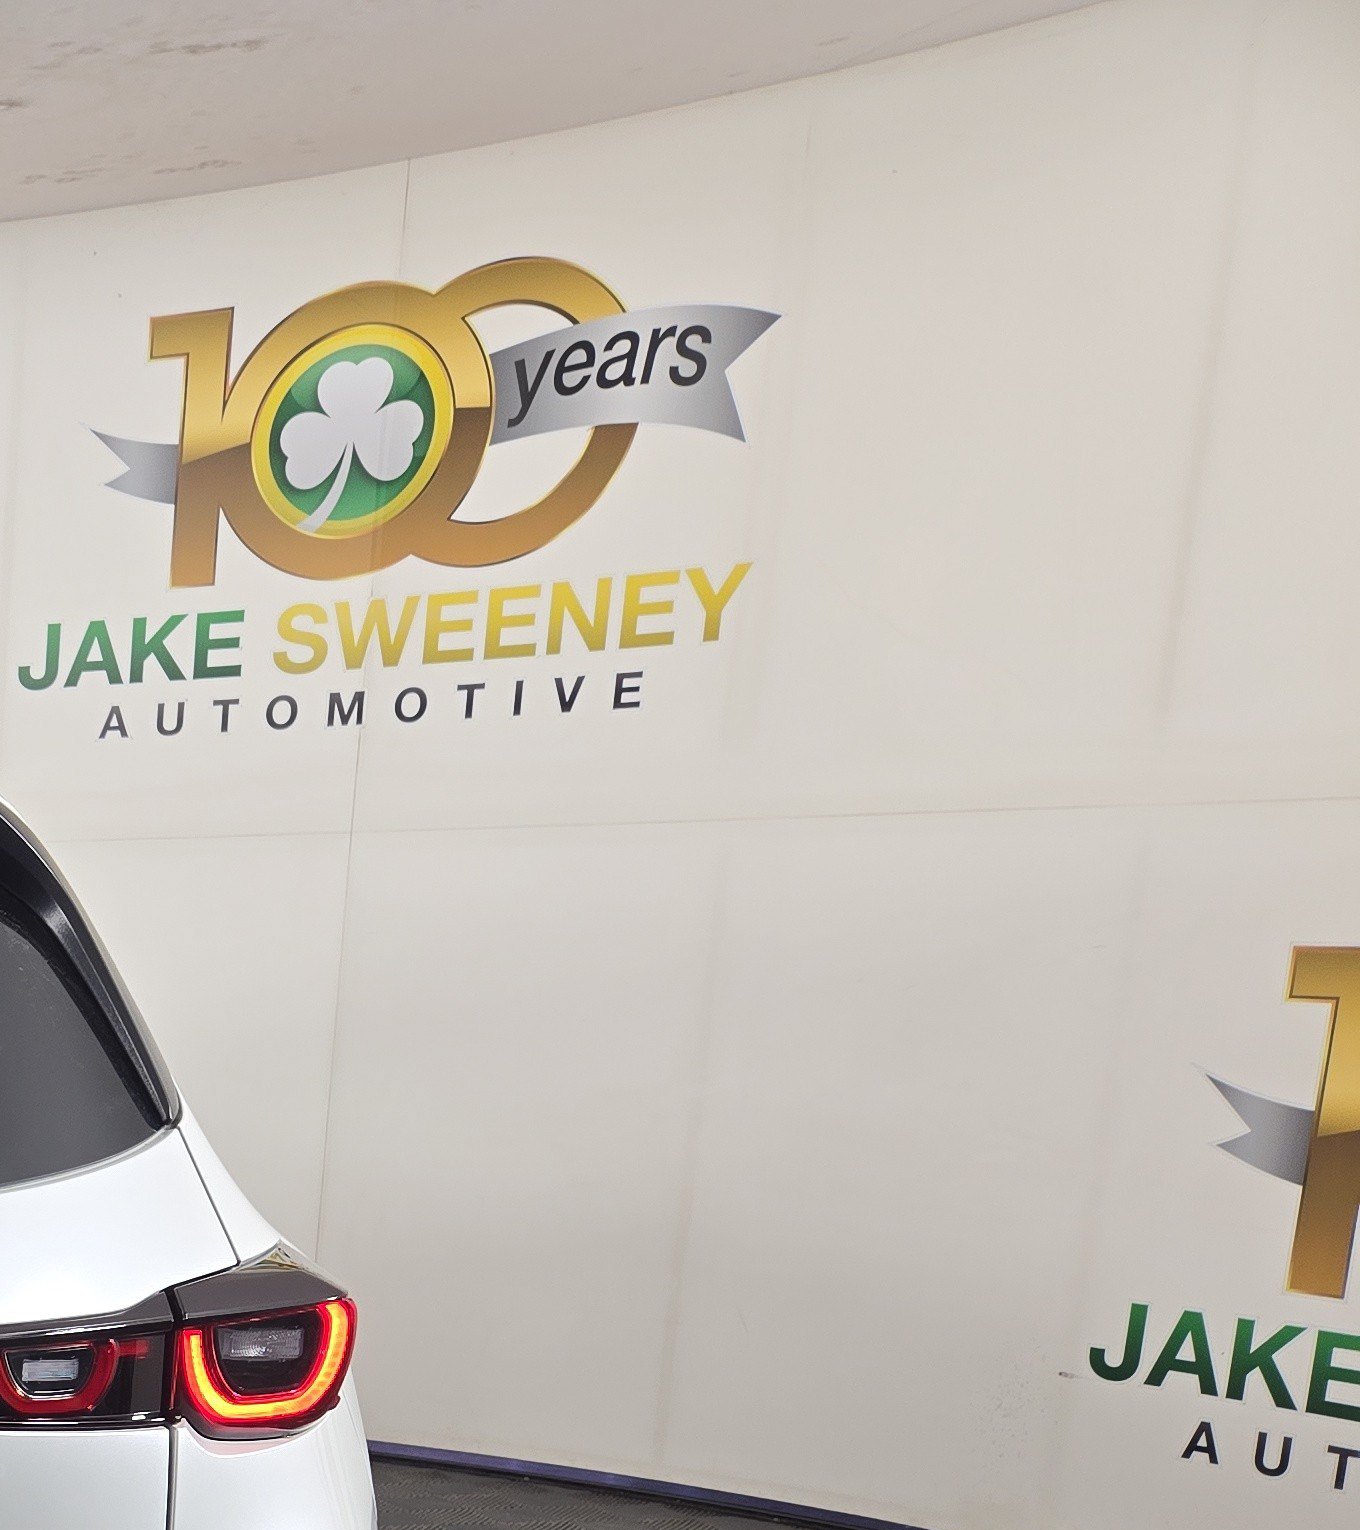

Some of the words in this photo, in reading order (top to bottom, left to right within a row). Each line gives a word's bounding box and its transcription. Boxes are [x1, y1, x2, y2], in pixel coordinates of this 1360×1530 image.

[149, 256, 639, 588] 100
[508, 323, 712, 428] years
[17, 610, 246, 692] JAKE
[272, 561, 754, 675] SWEENEY
[98, 670, 645, 740] AUTOMOTIVE
[1088, 1302, 1360, 1423] JAKE
